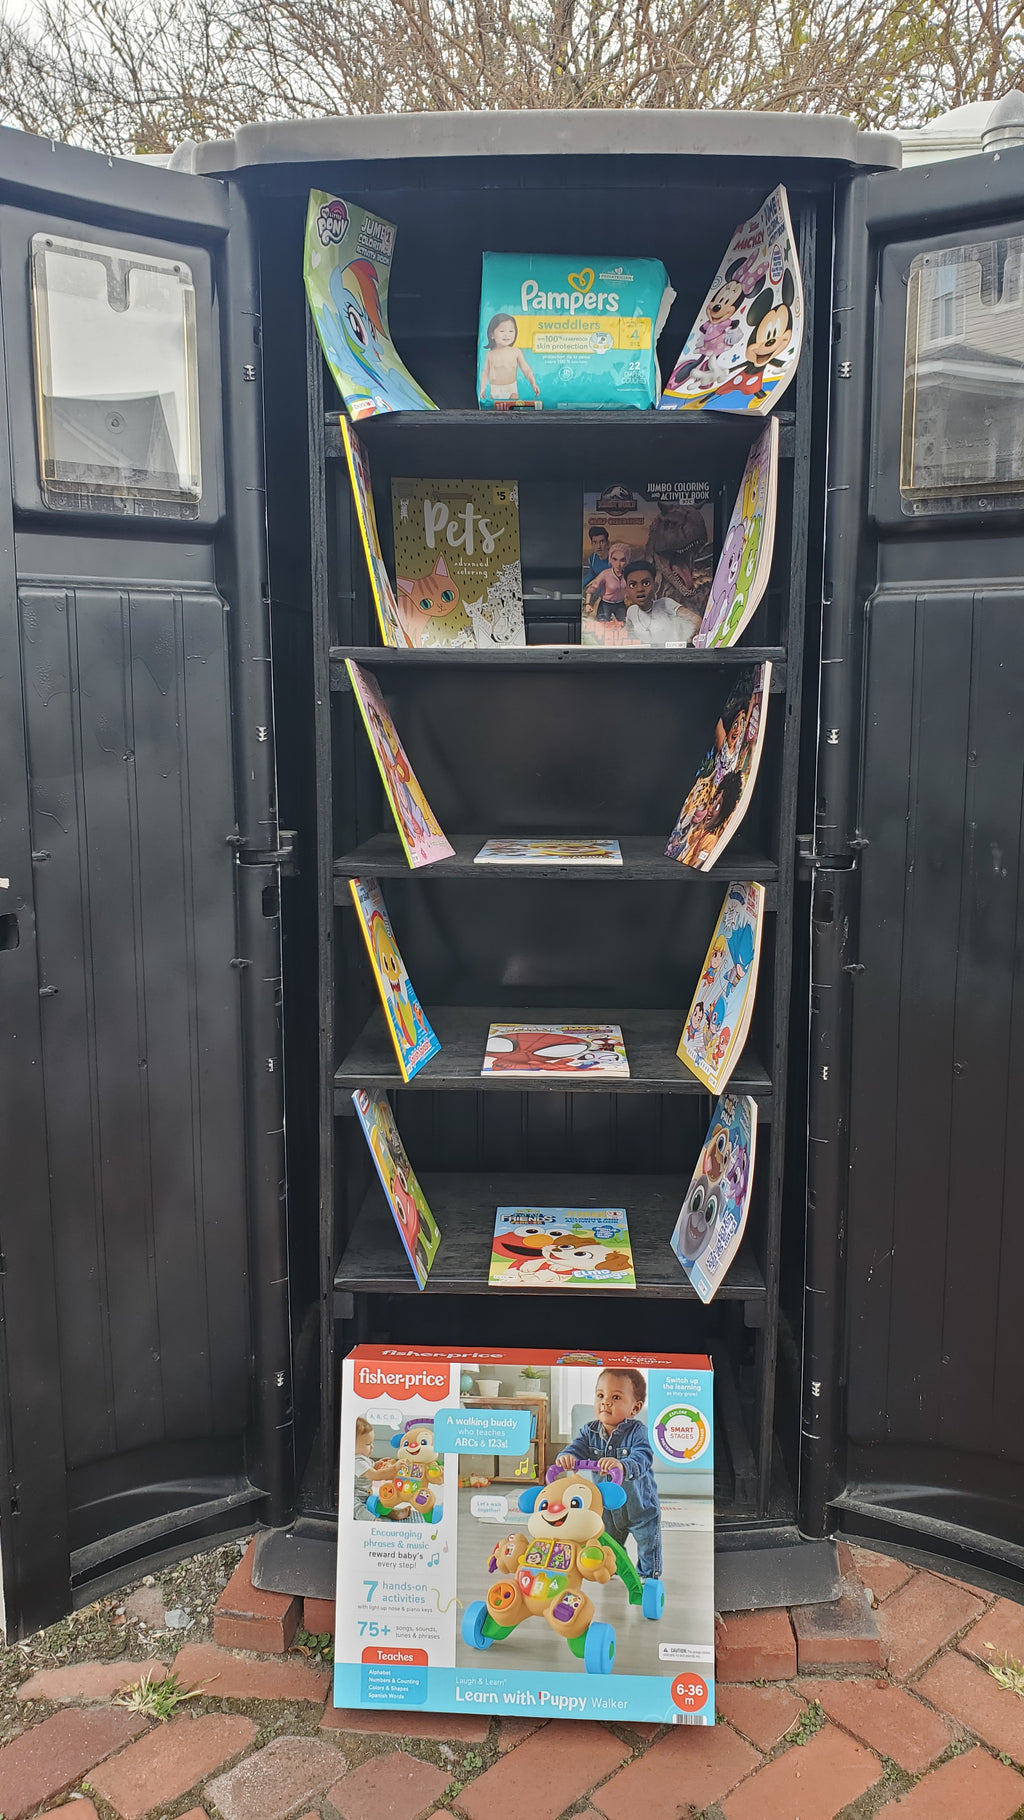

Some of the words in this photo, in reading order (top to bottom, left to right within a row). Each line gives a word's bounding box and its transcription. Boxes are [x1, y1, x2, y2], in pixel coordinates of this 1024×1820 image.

[318, 217, 349, 236] PONY
[733, 230, 765, 251] MICKEY
[521, 279, 620, 315] Pampers
[538, 319, 601, 330] swaddlers
[630, 329, 640, 340] 4
[536, 342, 550, 350] skin
[551, 343, 589, 351] protection
[629, 361, 641, 371] 22
[647, 483, 672, 493] JUMBO
[674, 481, 710, 492] COLORING
[660, 491, 690, 501] ACTIVITY
[691, 490, 710, 500] BOOK
[423, 499, 505, 556] Pets
[454, 557, 490, 568] advanced
[456, 568, 488, 579] coloring
[501, 1213, 553, 1223] FRIENDS
[665, 1376, 688, 1384] Switch
[675, 1384, 702, 1392] learning
[446, 1416, 454, 1425] A
[456, 1417, 489, 1428] walking
[490, 1418, 518, 1429] buddy
[476, 1429, 506, 1437] teaches
[455, 1438, 479, 1448] ABCs
[488, 1439, 508, 1448] 123s!
[371, 1528, 423, 1540] Encouraging
[363, 1539, 395, 1548] phrases
[397, 1540, 404, 1549] &
[398, 1551, 424, 1560] baby's
[377, 1561, 397, 1569] every
[363, 1580, 378, 1602] 7
[382, 1581, 428, 1591] hands-on
[382, 1593, 426, 1604] activities
[357, 1621, 391, 1637] 75+
[377, 1650, 414, 1662] Teaches
[368, 1668, 391, 1677] Alphabet
[368, 1676, 391, 1684] Numbers
[455, 1677, 477, 1686] Laugh
[485, 1678, 505, 1686] Learn
[390, 1685, 409, 1693] Shapes
[676, 1683, 704, 1697] 6-36
[456, 1686, 499, 1703] Learn
[503, 1690, 536, 1705] with
[538, 1691, 587, 1711] Puppy
[591, 1697, 628, 1709] Walker
[684, 1697, 695, 1705] m
